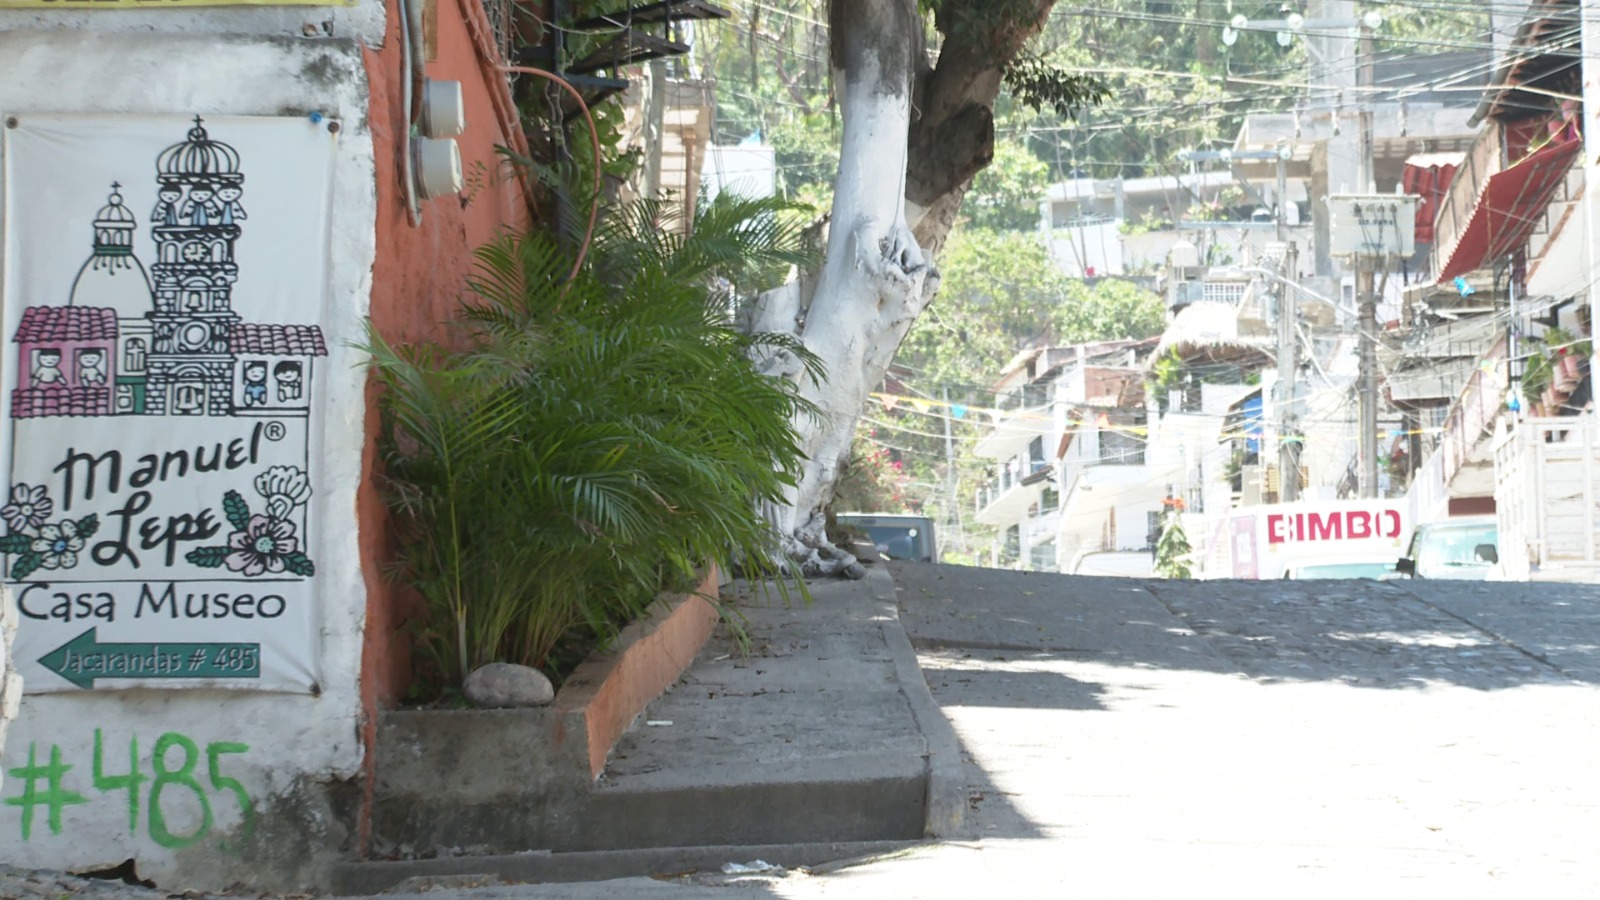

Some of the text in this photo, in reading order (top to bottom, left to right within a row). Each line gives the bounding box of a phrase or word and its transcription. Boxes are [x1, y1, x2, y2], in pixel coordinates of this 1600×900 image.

[91, 490, 222, 569] Lepe
[1267, 509, 1402, 544] BIMBO
[17, 581, 287, 622] Casa Museo
[57, 646, 182, 674] Jacarandas
[212, 647, 258, 672] 485
